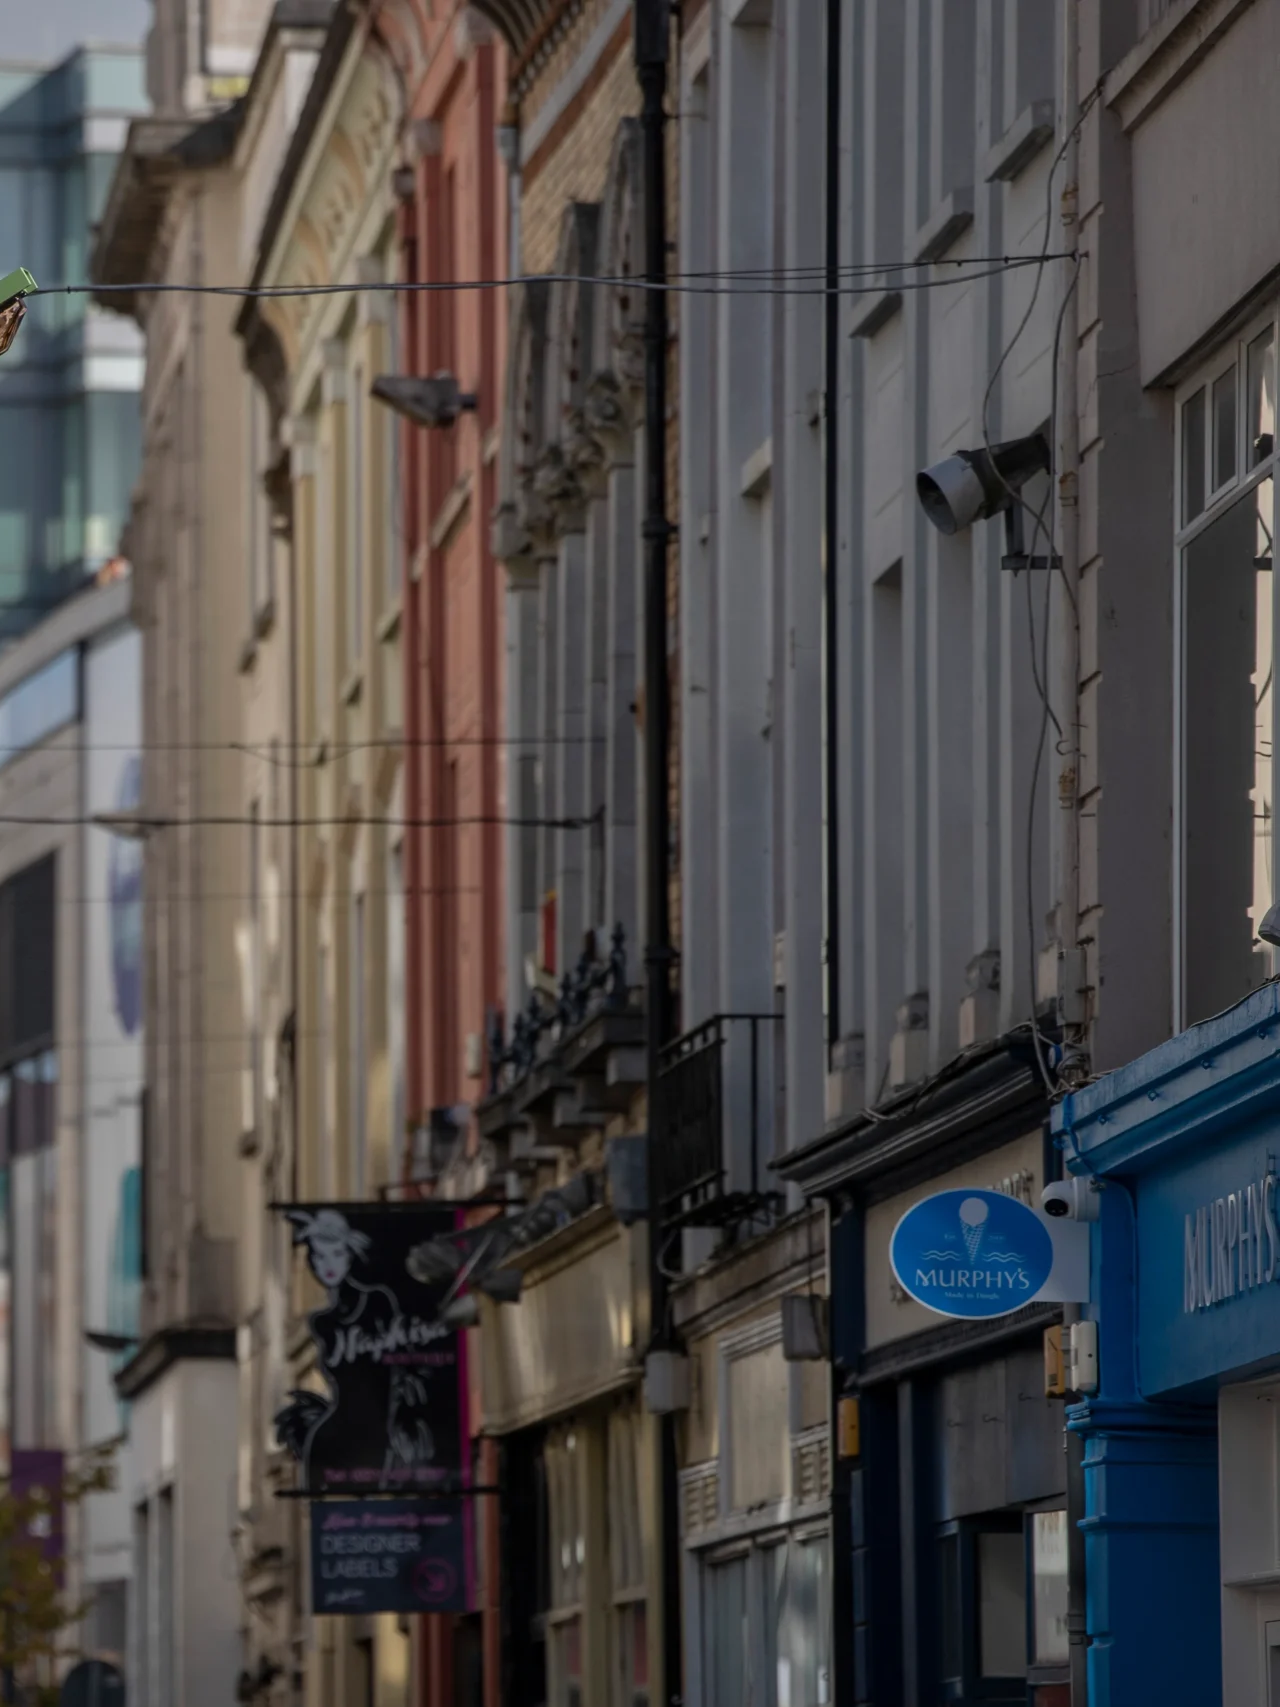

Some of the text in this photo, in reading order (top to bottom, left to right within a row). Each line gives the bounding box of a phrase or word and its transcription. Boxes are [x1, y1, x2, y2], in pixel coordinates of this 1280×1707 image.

[914, 1267, 1031, 1290] MURPHY'S
[320, 1532, 422, 1555] DESIGNER
[320, 1556, 400, 1580] LABELS
